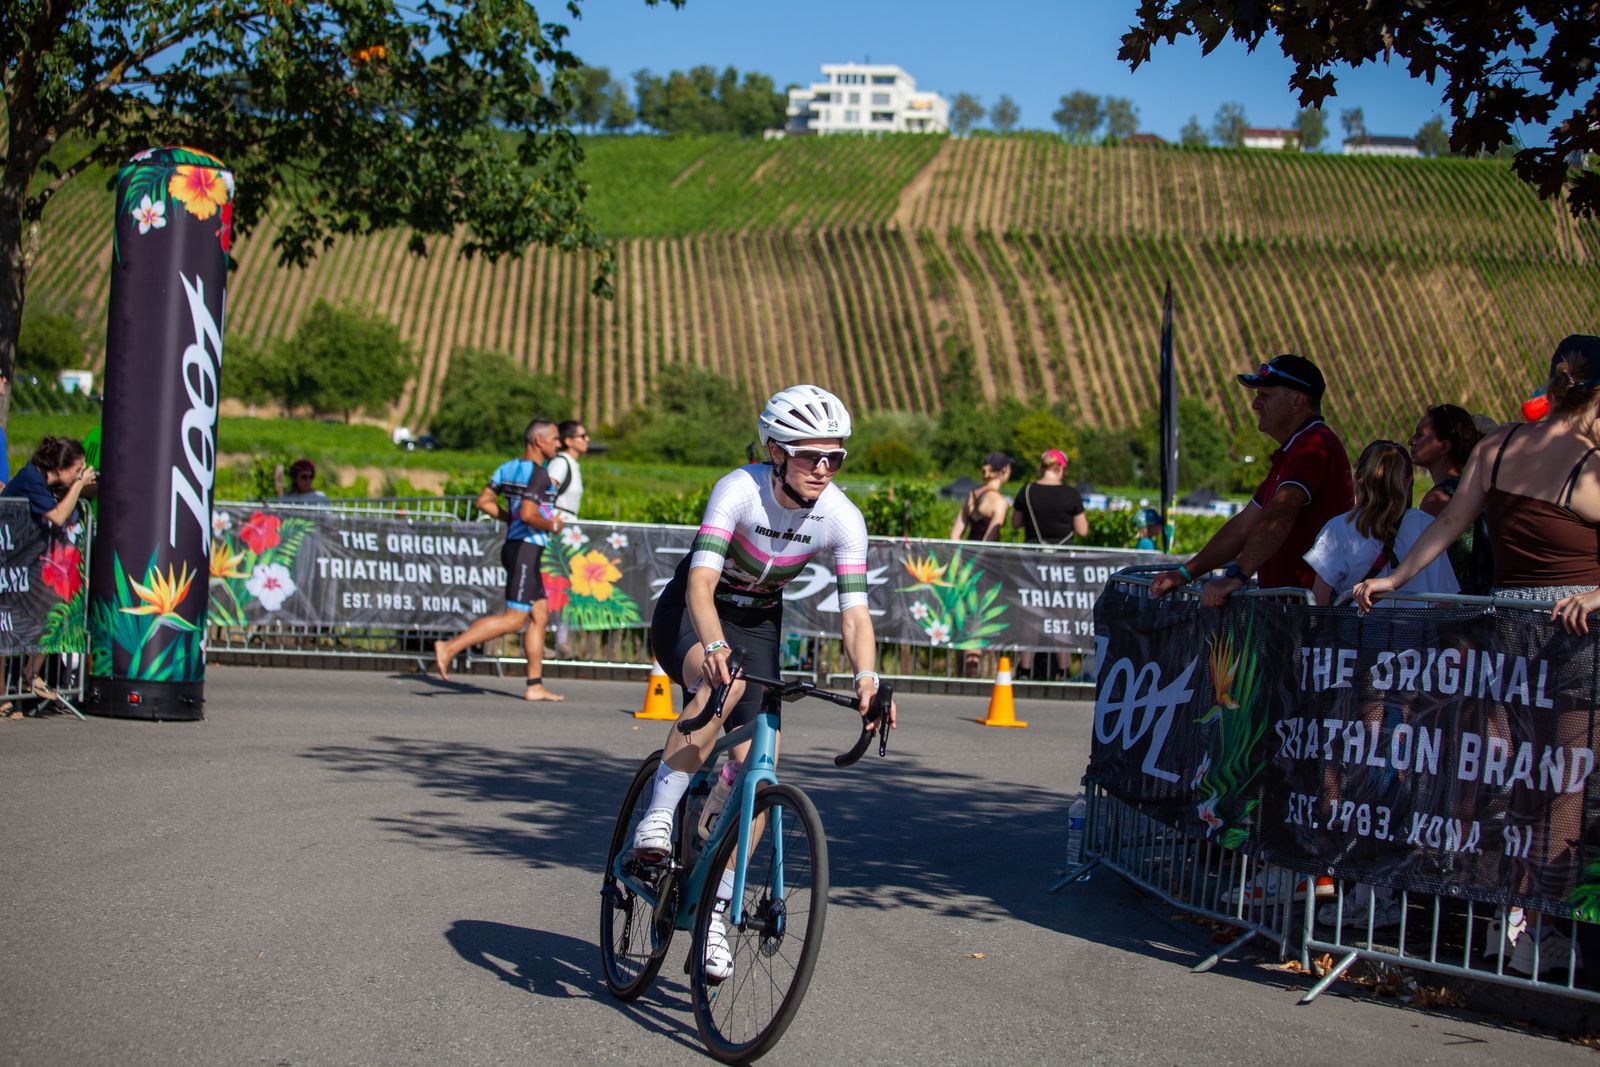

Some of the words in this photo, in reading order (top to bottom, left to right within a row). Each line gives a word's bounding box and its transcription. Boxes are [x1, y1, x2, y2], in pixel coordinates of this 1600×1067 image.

[338, 530, 379, 551] THE
[386, 533, 485, 557] ORIGINAL
[317, 557, 433, 584] TRIATHLON
[439, 564, 508, 587] BRAND
[1036, 565, 1077, 583] THE
[342, 591, 373, 609] EST.
[471, 598, 488, 614] HI
[1043, 618, 1072, 635] EST.
[1301, 647, 1358, 693] THE
[1371, 648, 1554, 709] ORIGINAL
[1457, 731, 1594, 793] BRAND
[1503, 825, 1533, 859] HI
